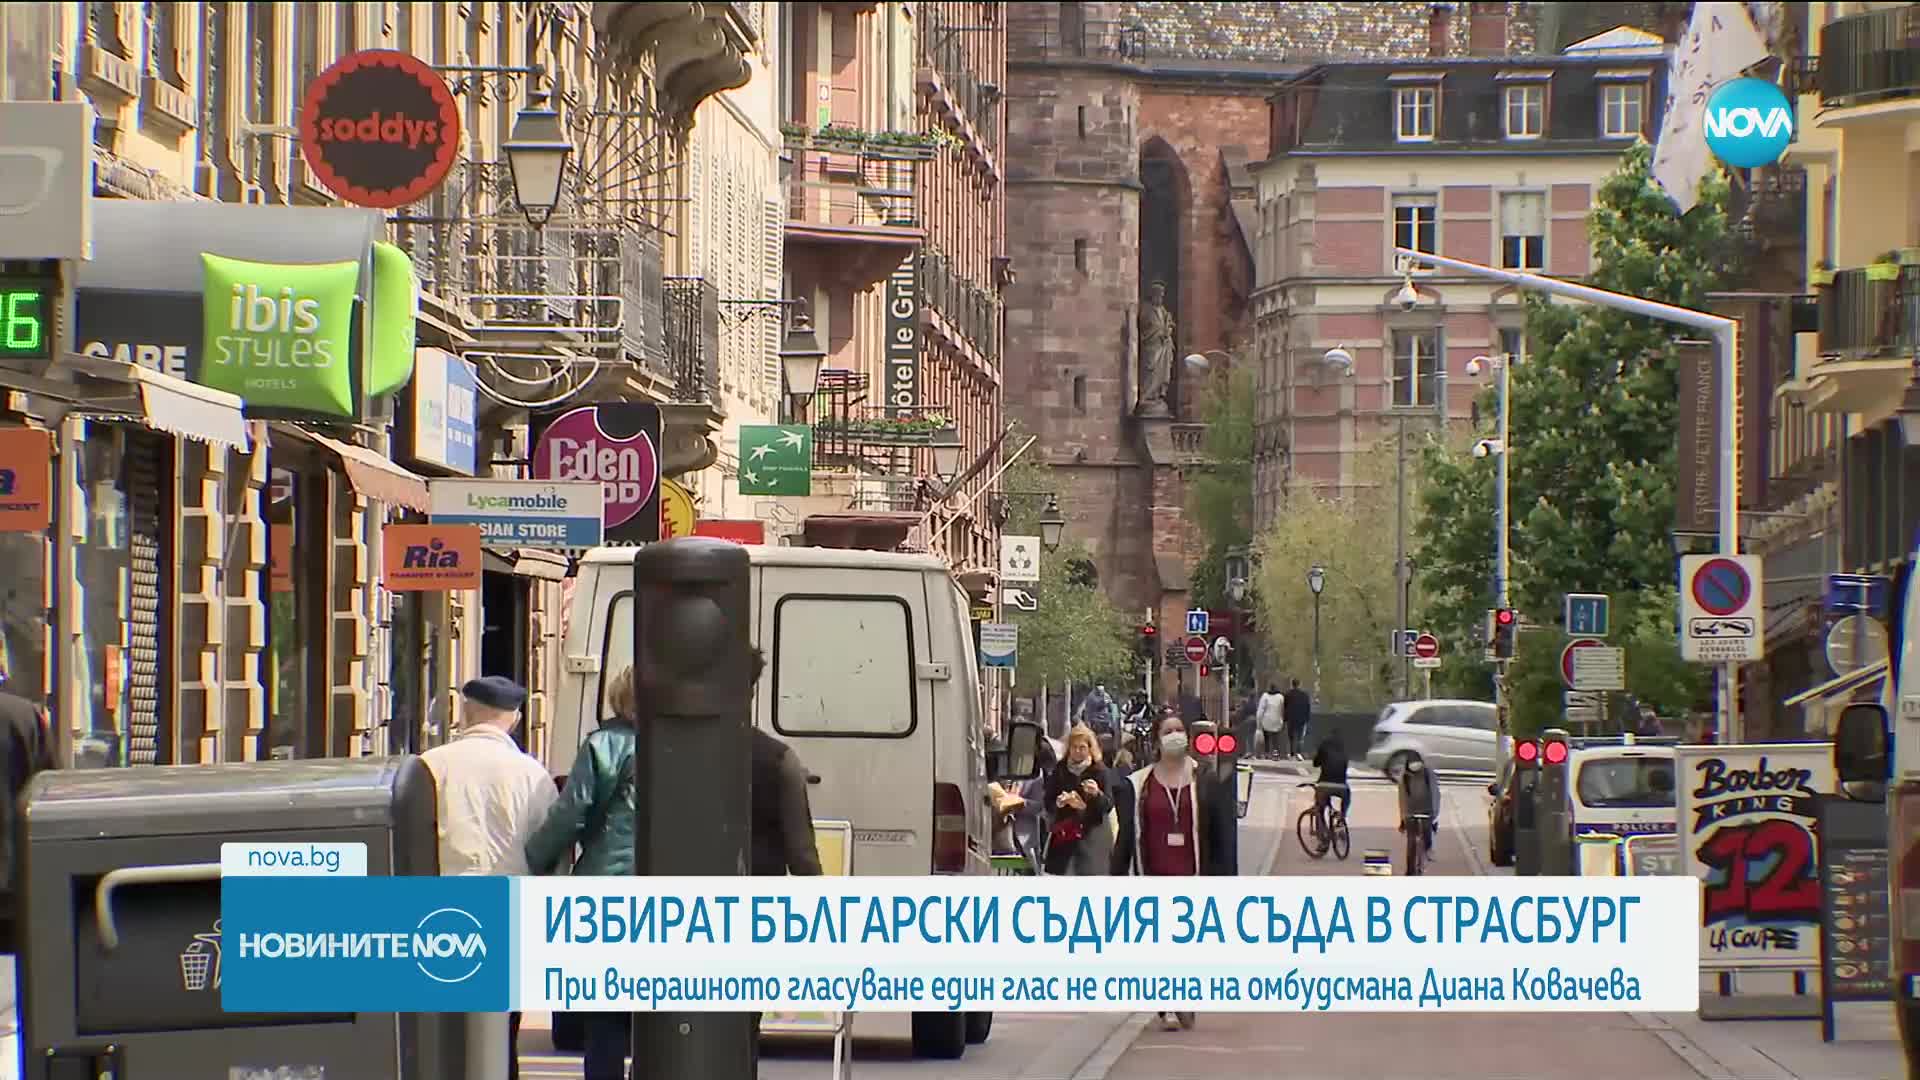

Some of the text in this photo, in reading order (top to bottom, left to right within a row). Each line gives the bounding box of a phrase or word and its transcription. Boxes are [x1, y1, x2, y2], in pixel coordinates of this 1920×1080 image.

[319, 111, 438, 149] soddys
[230, 282, 320, 334] ibis
[891, 327, 914, 349] le
[245, 377, 297, 390] HOTELS
[549, 438, 640, 481] Eden
[467, 493, 568, 510] Lycamobile
[469, 522, 568, 538] SIAN STORE
[403, 538, 459, 568] Ria
[1712, 797, 1793, 820] KING
[1613, 822, 1660, 831] POLICE
[1696, 818, 1821, 923] 12
[1710, 928, 1728, 952] LA
